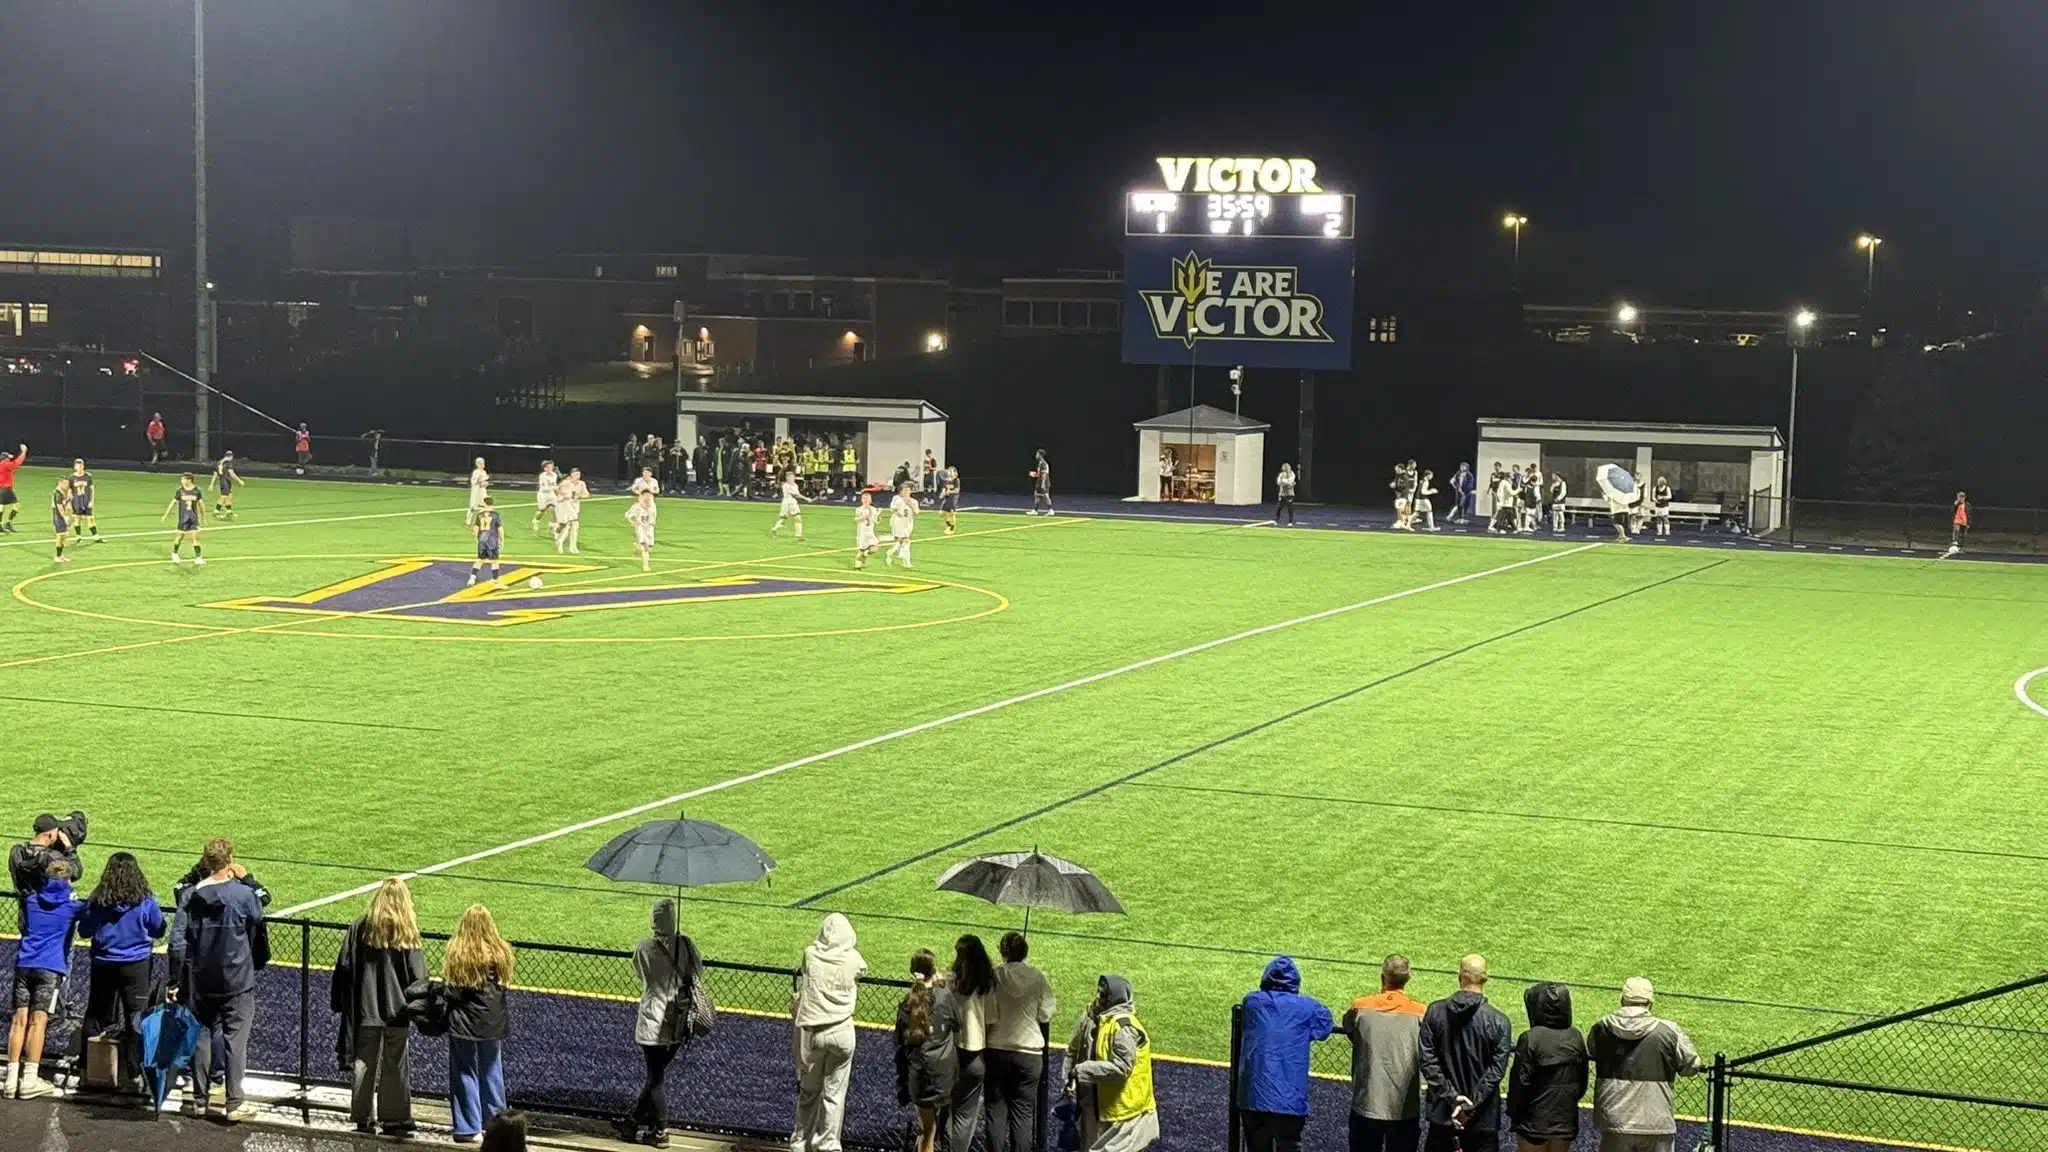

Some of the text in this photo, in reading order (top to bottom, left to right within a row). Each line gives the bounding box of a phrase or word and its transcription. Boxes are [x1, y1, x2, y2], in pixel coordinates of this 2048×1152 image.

[1156, 157, 1323, 193] VICTOR
[1208, 194, 1270, 218] 35:59
[1324, 214, 1341, 237] 2
[1231, 272, 1292, 298] ARE
[1150, 296, 1320, 338] VICTOR
